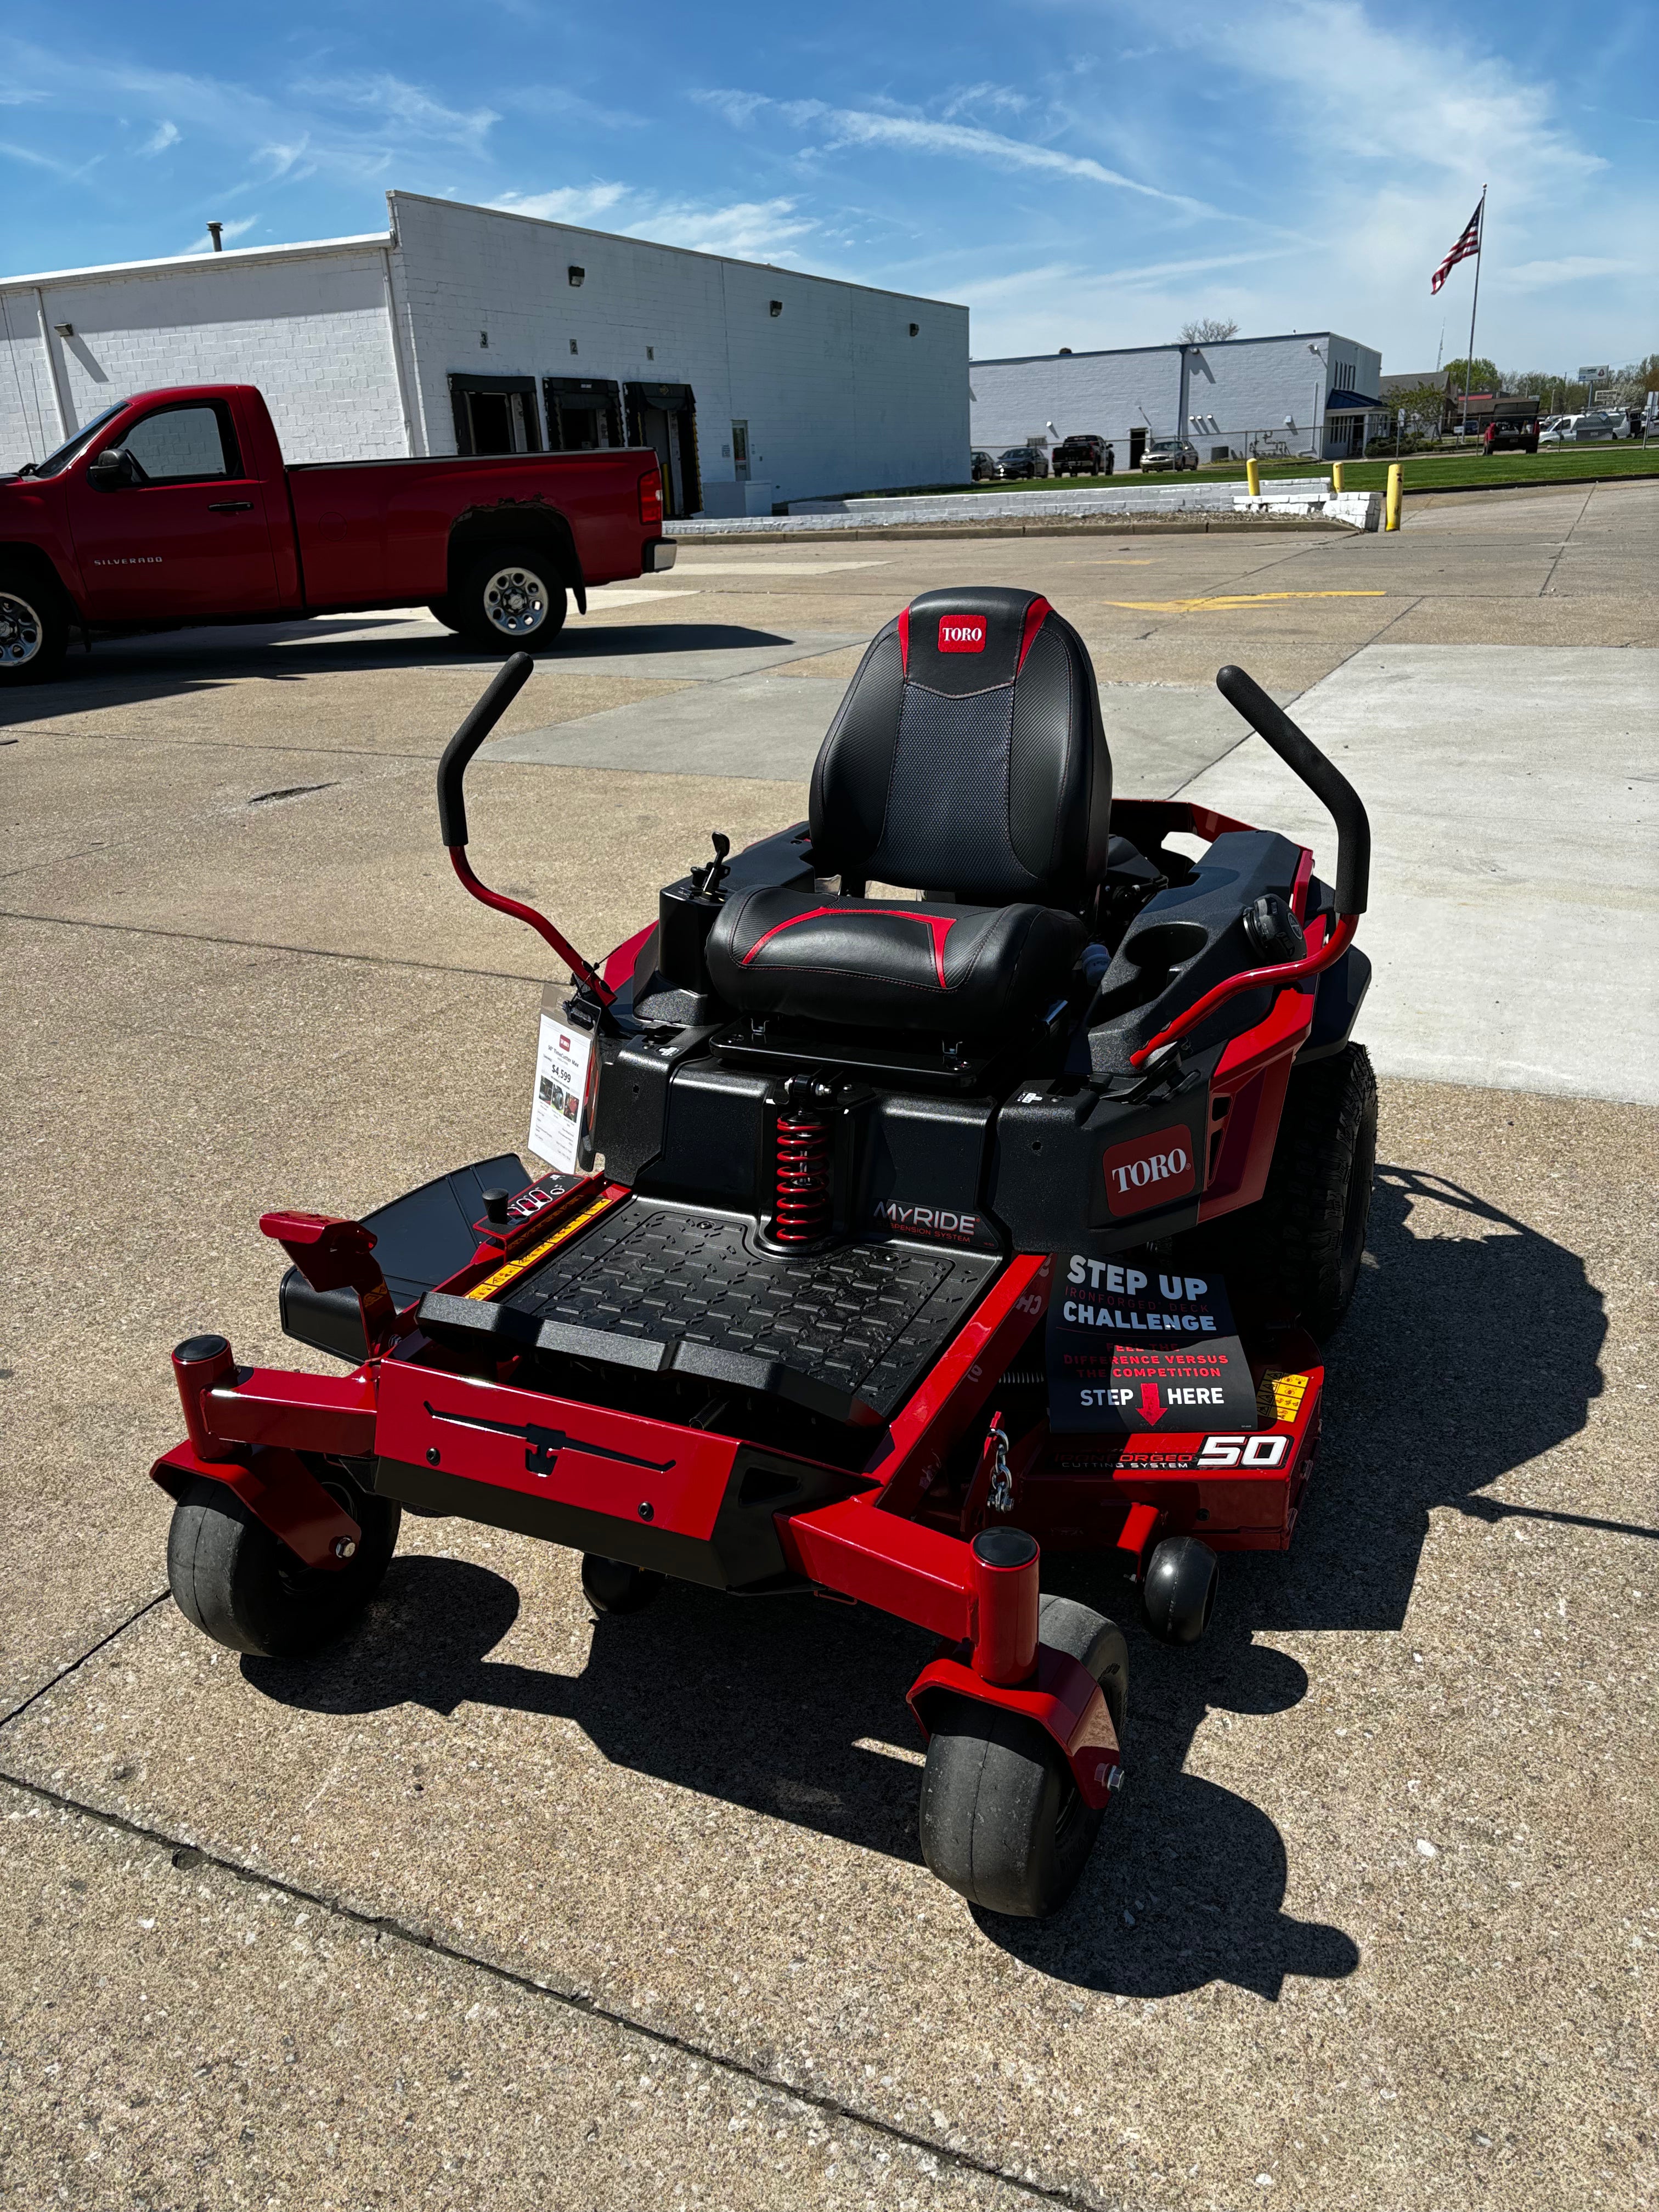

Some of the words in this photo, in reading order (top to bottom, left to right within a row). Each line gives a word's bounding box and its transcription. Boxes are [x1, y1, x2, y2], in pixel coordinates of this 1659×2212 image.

[480, 332, 487, 346] 3
[571, 341, 578, 352] 2
[94, 556, 163, 566] SILVERADO
[942, 627, 983, 641] TORO
[551, 1064, 571, 1083] $4,599
[1111, 1148, 1187, 1193] TORO
[934, 1231, 970, 1243] SYSTEM
[1066, 1255, 1148, 1295] STEP
[1159, 1274, 1208, 1301] UP
[1169, 1302, 1210, 1313] DECK
[1063, 1301, 1217, 1331] CHALLENGE
[1107, 1342, 1144, 1352] FEEL
[1149, 1343, 1180, 1352] THE
[1064, 1354, 1160, 1364] DIFFERENCE
[1164, 1355, 1228, 1364] VERSUS
[1076, 1369, 1107, 1378] THE
[1112, 1368, 1221, 1378] COMPETITION
[1080, 1388, 1134, 1406] STEP
[1167, 1387, 1224, 1405] HERE
[1197, 1436, 1289, 1466] 50
